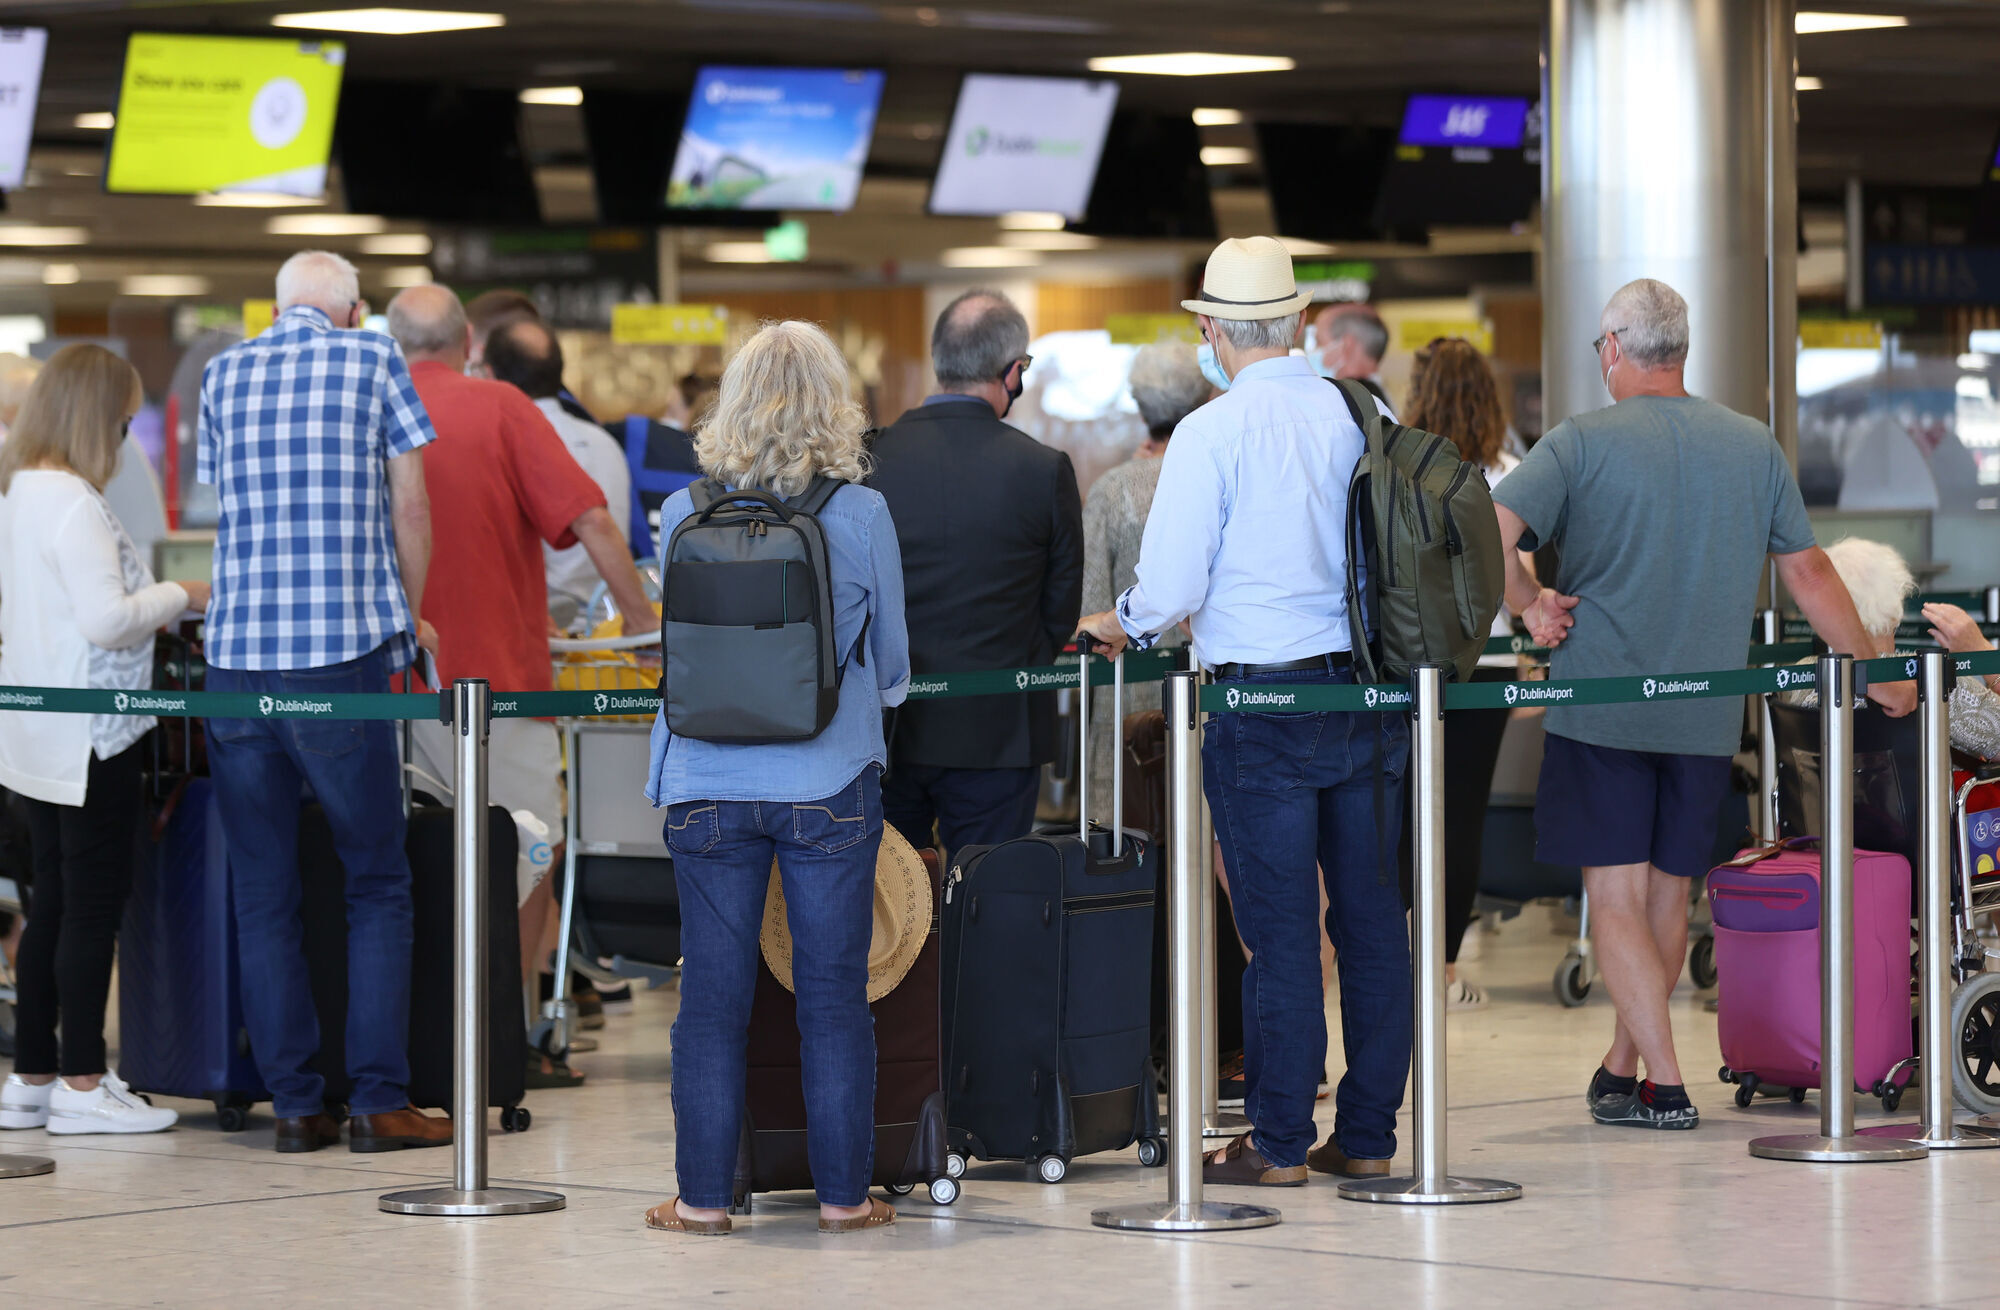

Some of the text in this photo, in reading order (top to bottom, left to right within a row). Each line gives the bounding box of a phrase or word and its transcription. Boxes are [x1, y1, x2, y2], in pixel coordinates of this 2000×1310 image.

[1031, 671, 1080, 685] DublinAirport
[908, 681, 948, 694] blinAirport
[1520, 687, 1573, 701] DublinAirport
[1658, 680, 1709, 694] DublinAirport
[0, 692, 44, 706] blinAirport
[130, 697, 186, 711] DublinAirport
[611, 696, 664, 710] DublinAirpor
[1242, 692, 1295, 706] DublinAirport
[1380, 691, 1411, 703] DublinA
[276, 700, 333, 714] DublinAirport
